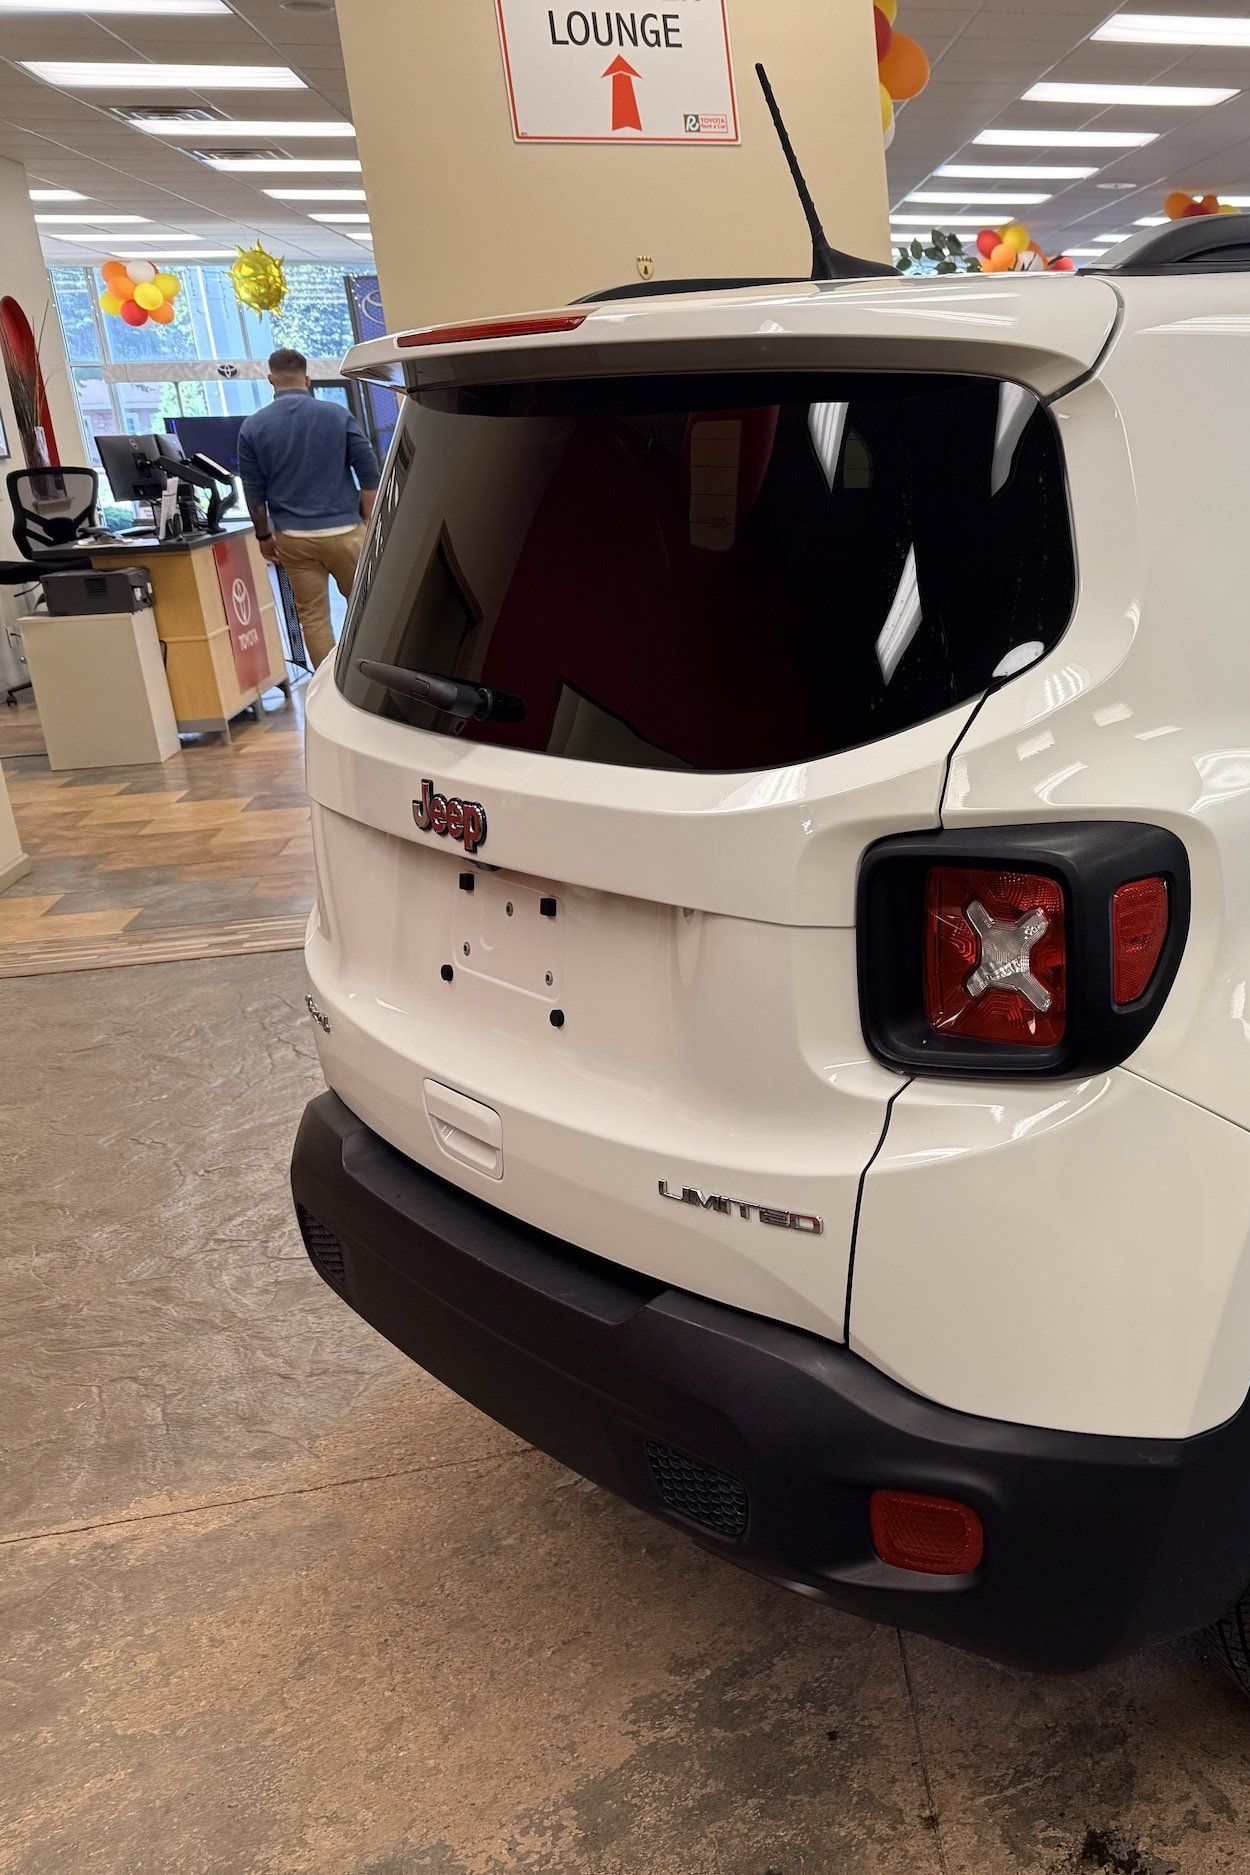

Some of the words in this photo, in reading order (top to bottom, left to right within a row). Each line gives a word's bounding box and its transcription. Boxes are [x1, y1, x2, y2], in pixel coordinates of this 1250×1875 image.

[547, 10, 683, 48] LOUNGE
[238, 628, 259, 651] TOYOTA
[412, 778, 487, 853] Jeep
[658, 1178, 824, 1235] LIMITED
